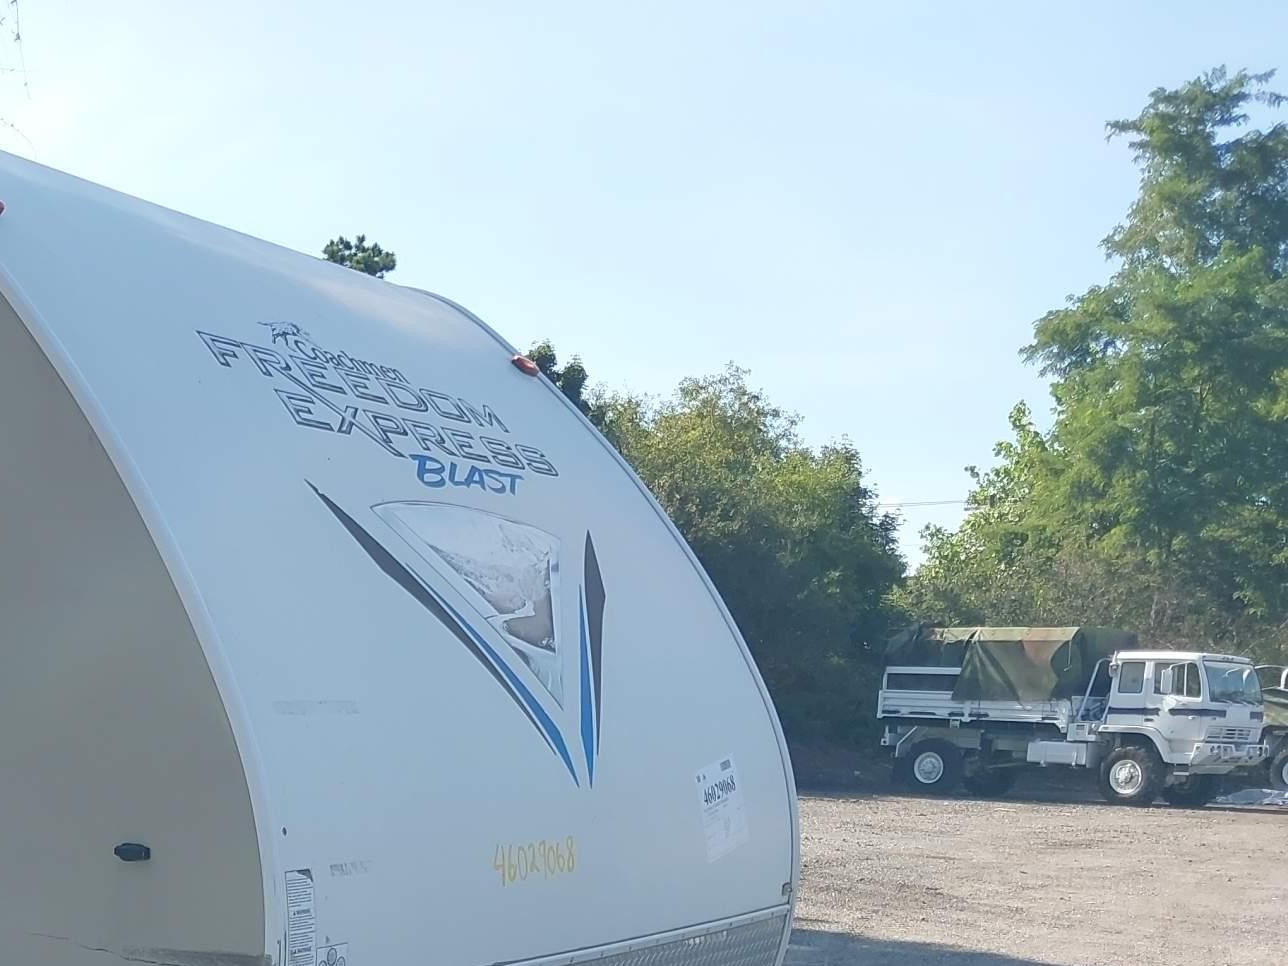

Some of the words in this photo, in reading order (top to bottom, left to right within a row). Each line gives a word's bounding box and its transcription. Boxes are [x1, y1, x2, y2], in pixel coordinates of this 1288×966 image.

[195, 330, 511, 434] FREEDOM
[294, 339, 408, 383] Coachmen
[273, 388, 559, 477] EXPRESS
[409, 453, 524, 496] BLAST
[703, 774, 736, 806] 46029068
[493, 835, 576, 887] 46029068
